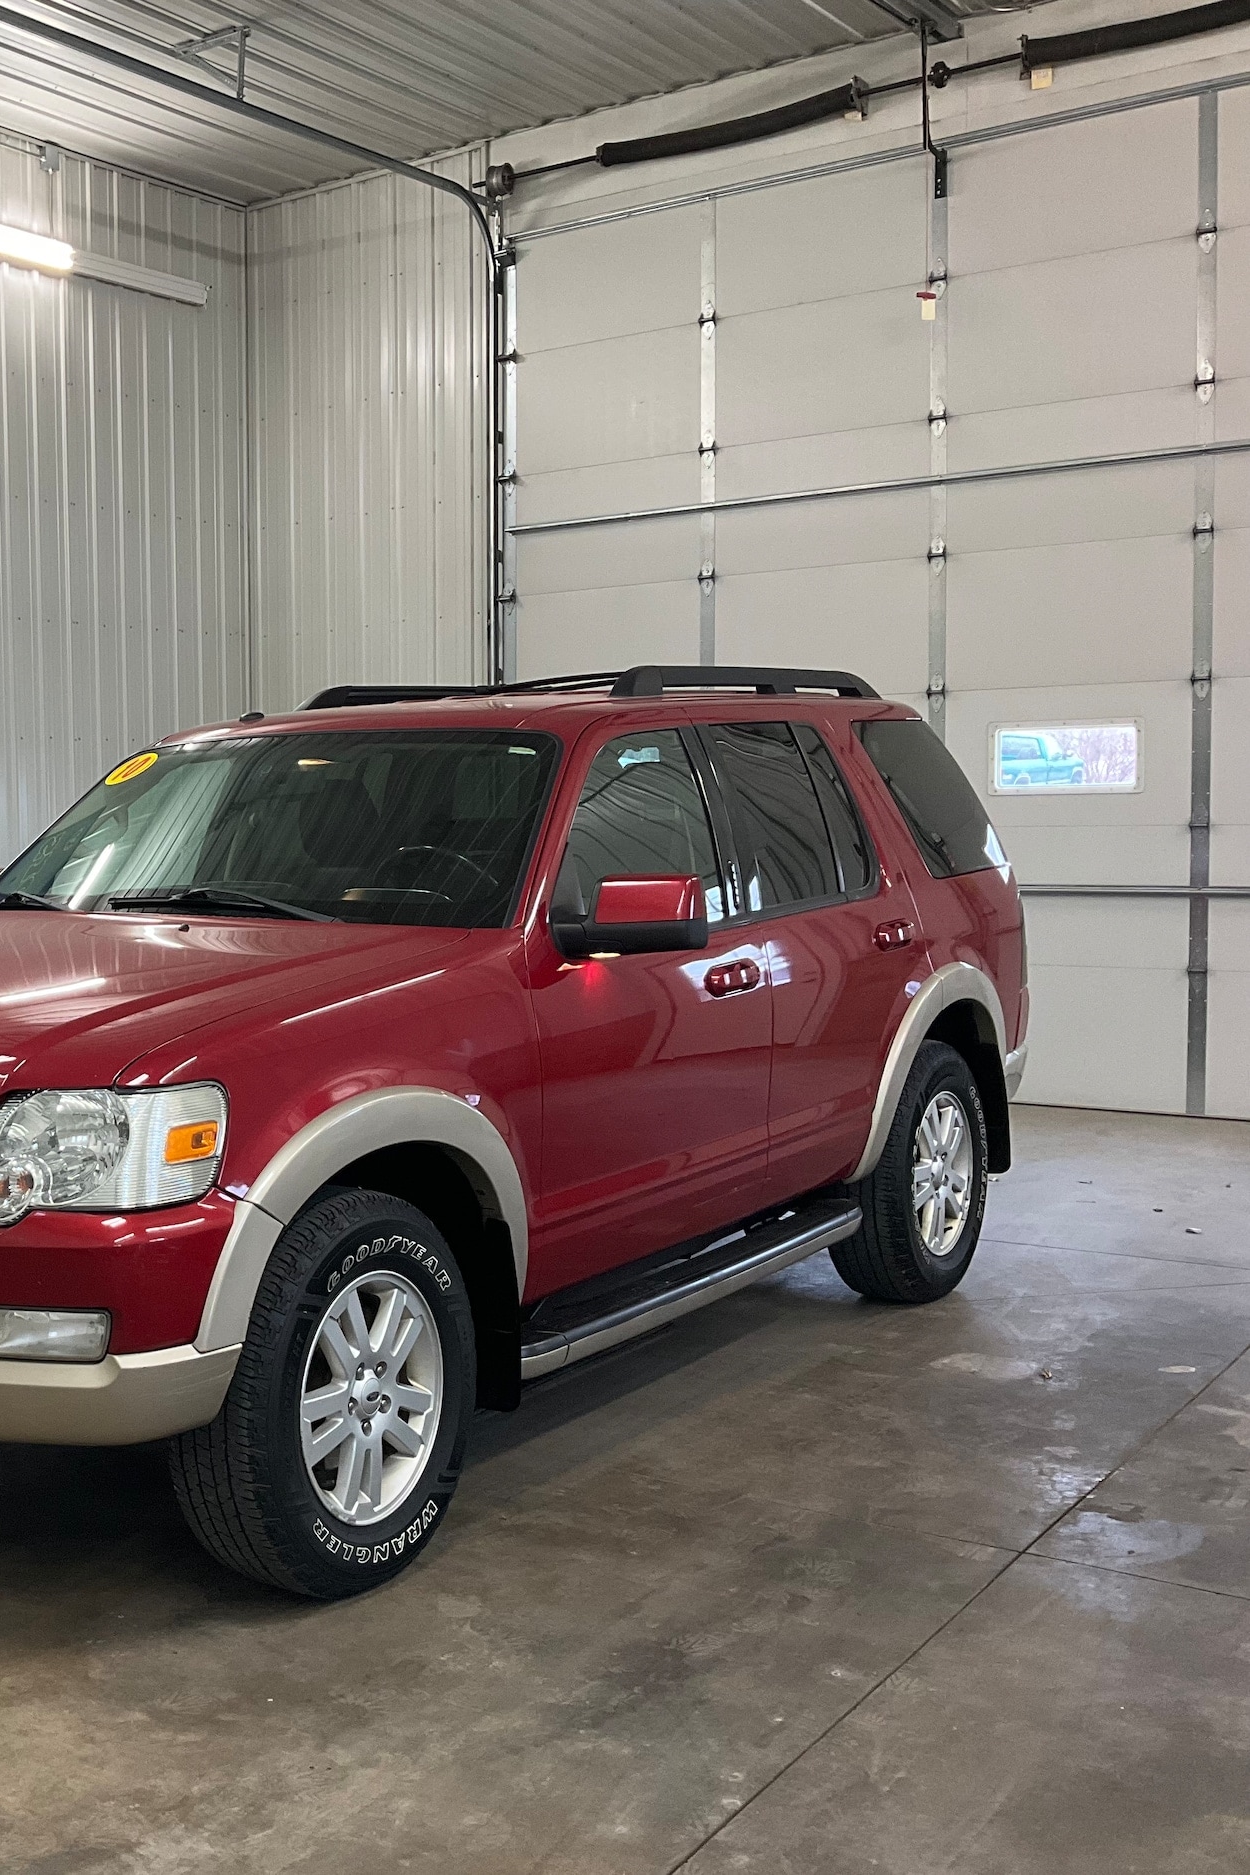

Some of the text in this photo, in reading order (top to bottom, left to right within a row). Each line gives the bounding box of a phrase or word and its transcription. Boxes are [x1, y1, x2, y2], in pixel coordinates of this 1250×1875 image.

[968, 1085, 989, 1220] GOODYEAR
[327, 1235, 452, 1293] GOODYEAR
[312, 1500, 438, 1564] WRANGLER
